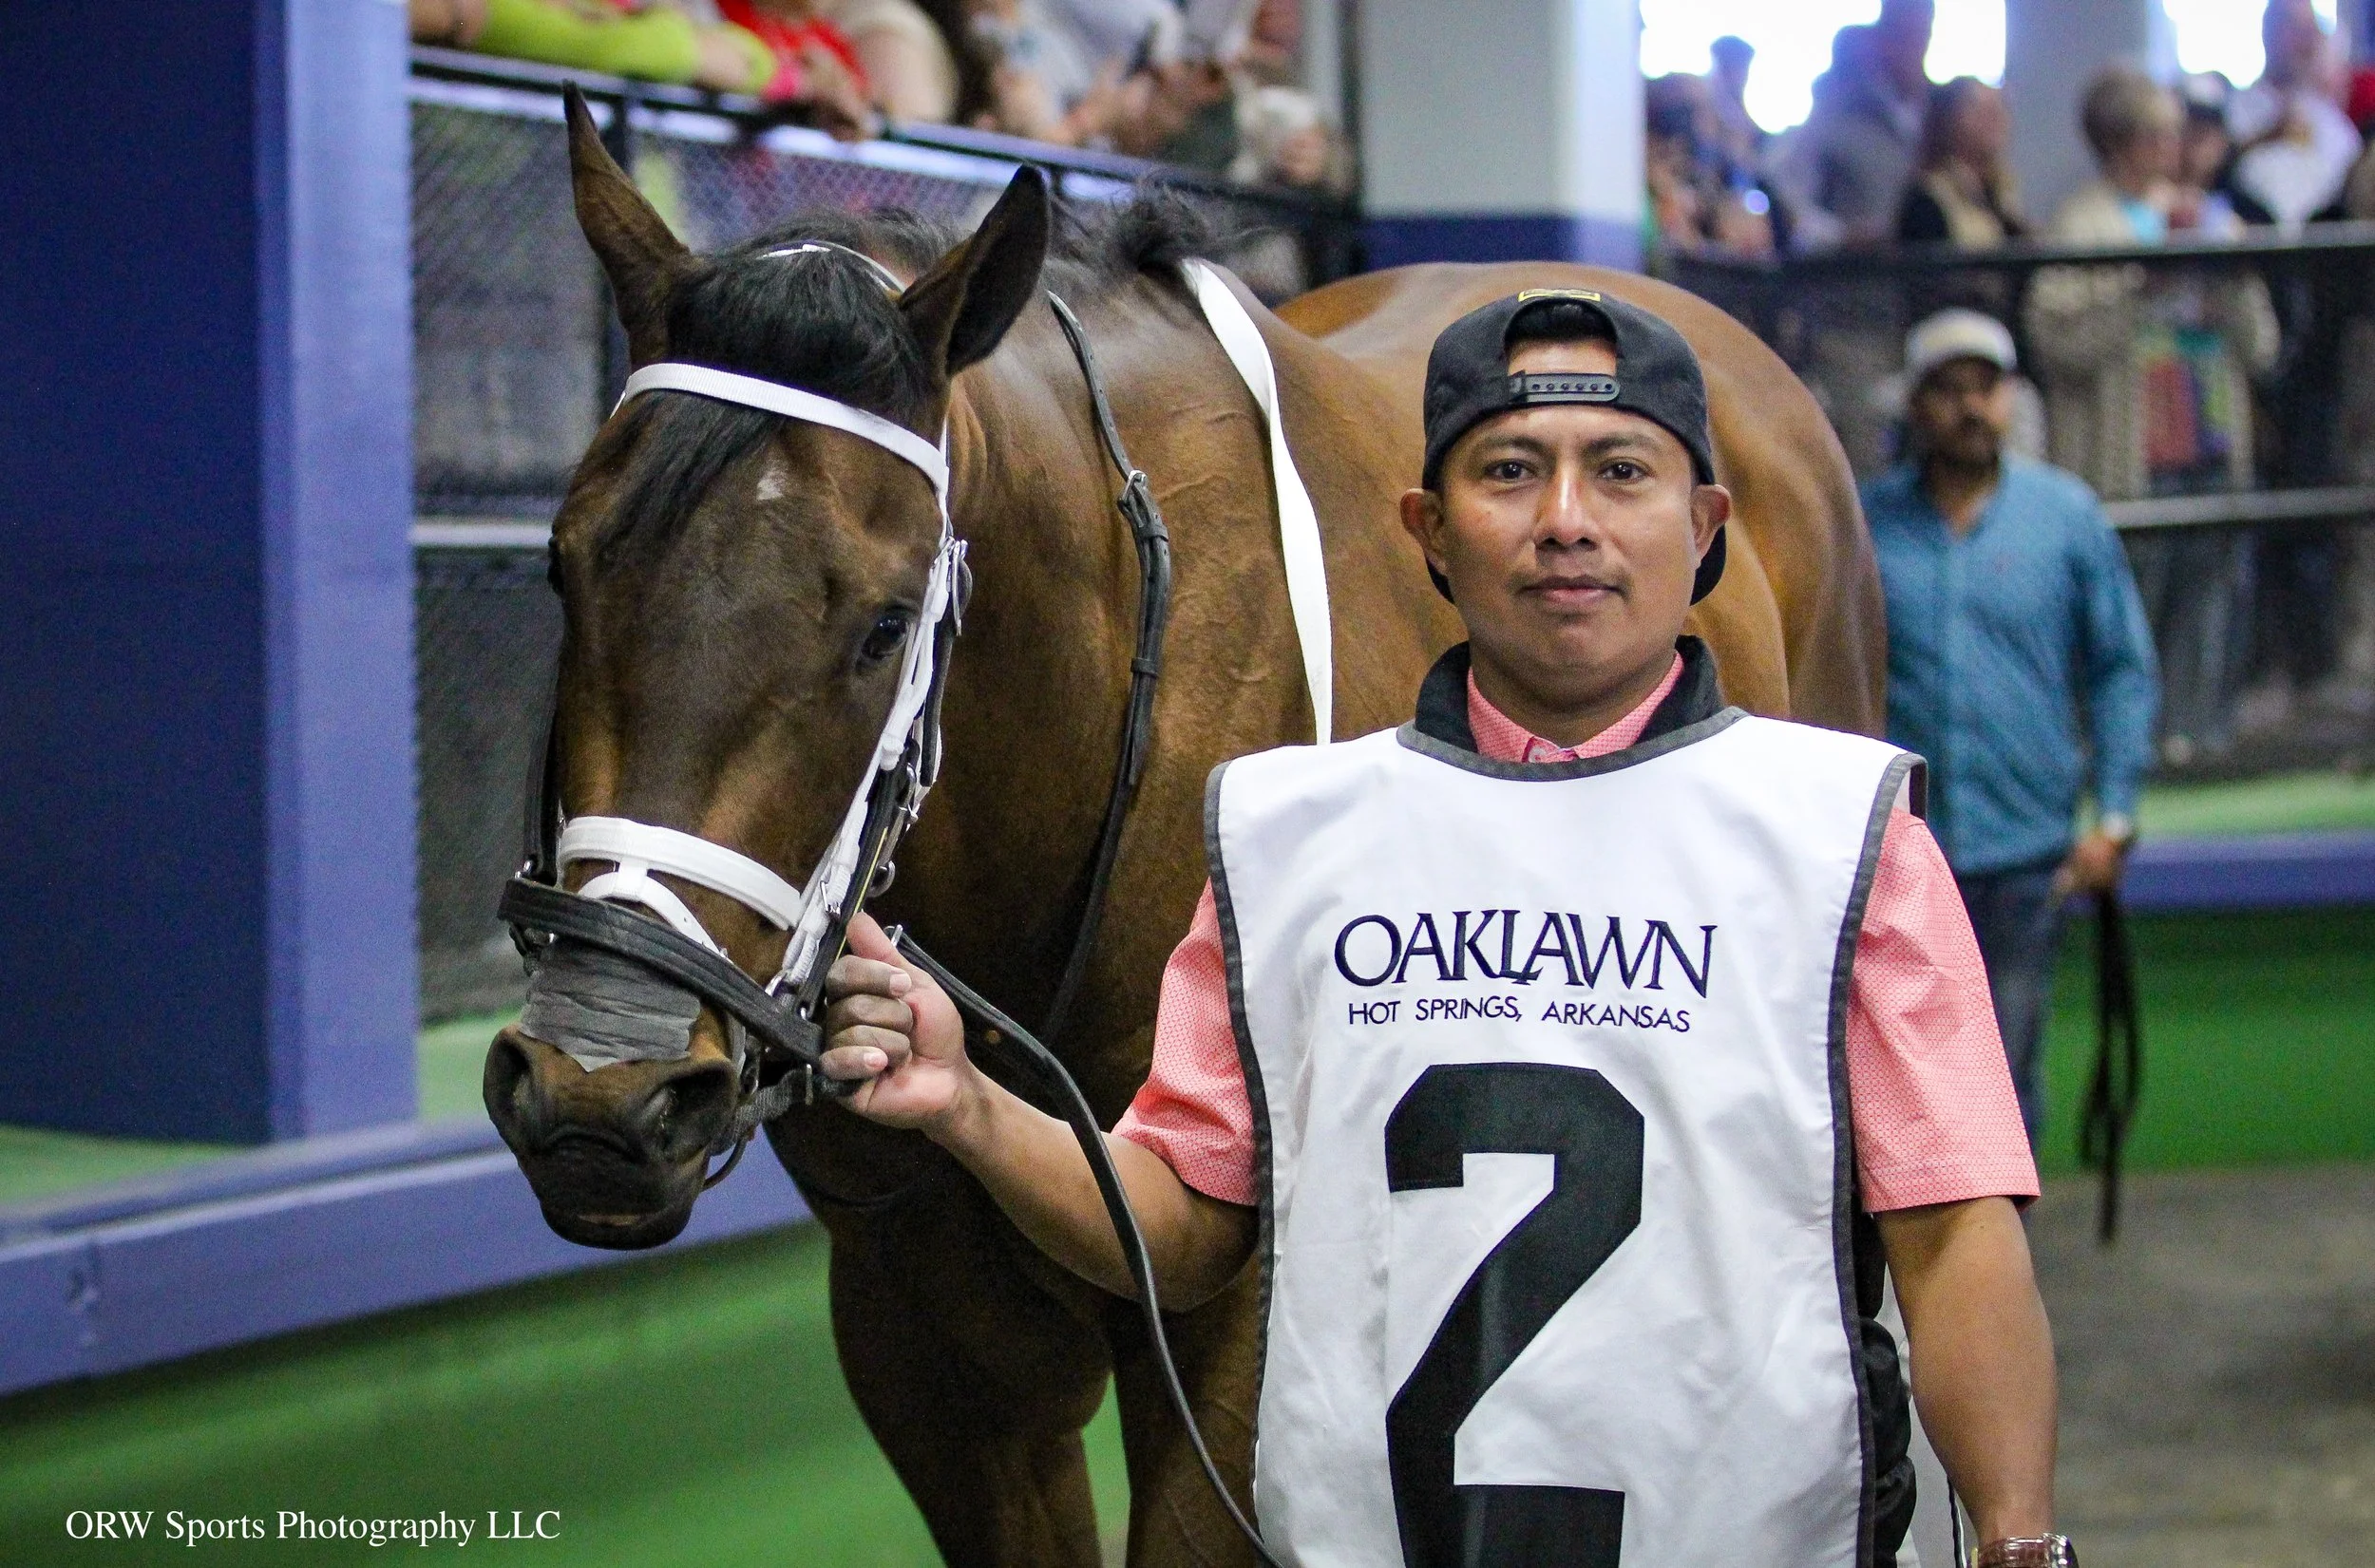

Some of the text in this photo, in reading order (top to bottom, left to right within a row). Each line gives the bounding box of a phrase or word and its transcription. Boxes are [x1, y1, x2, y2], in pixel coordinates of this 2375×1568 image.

[1334, 909, 1718, 998] OAKLAWN
[1349, 995, 1691, 1033] HOT SPRINGS, ARKANSAS
[1384, 1063, 1644, 1568] 2
